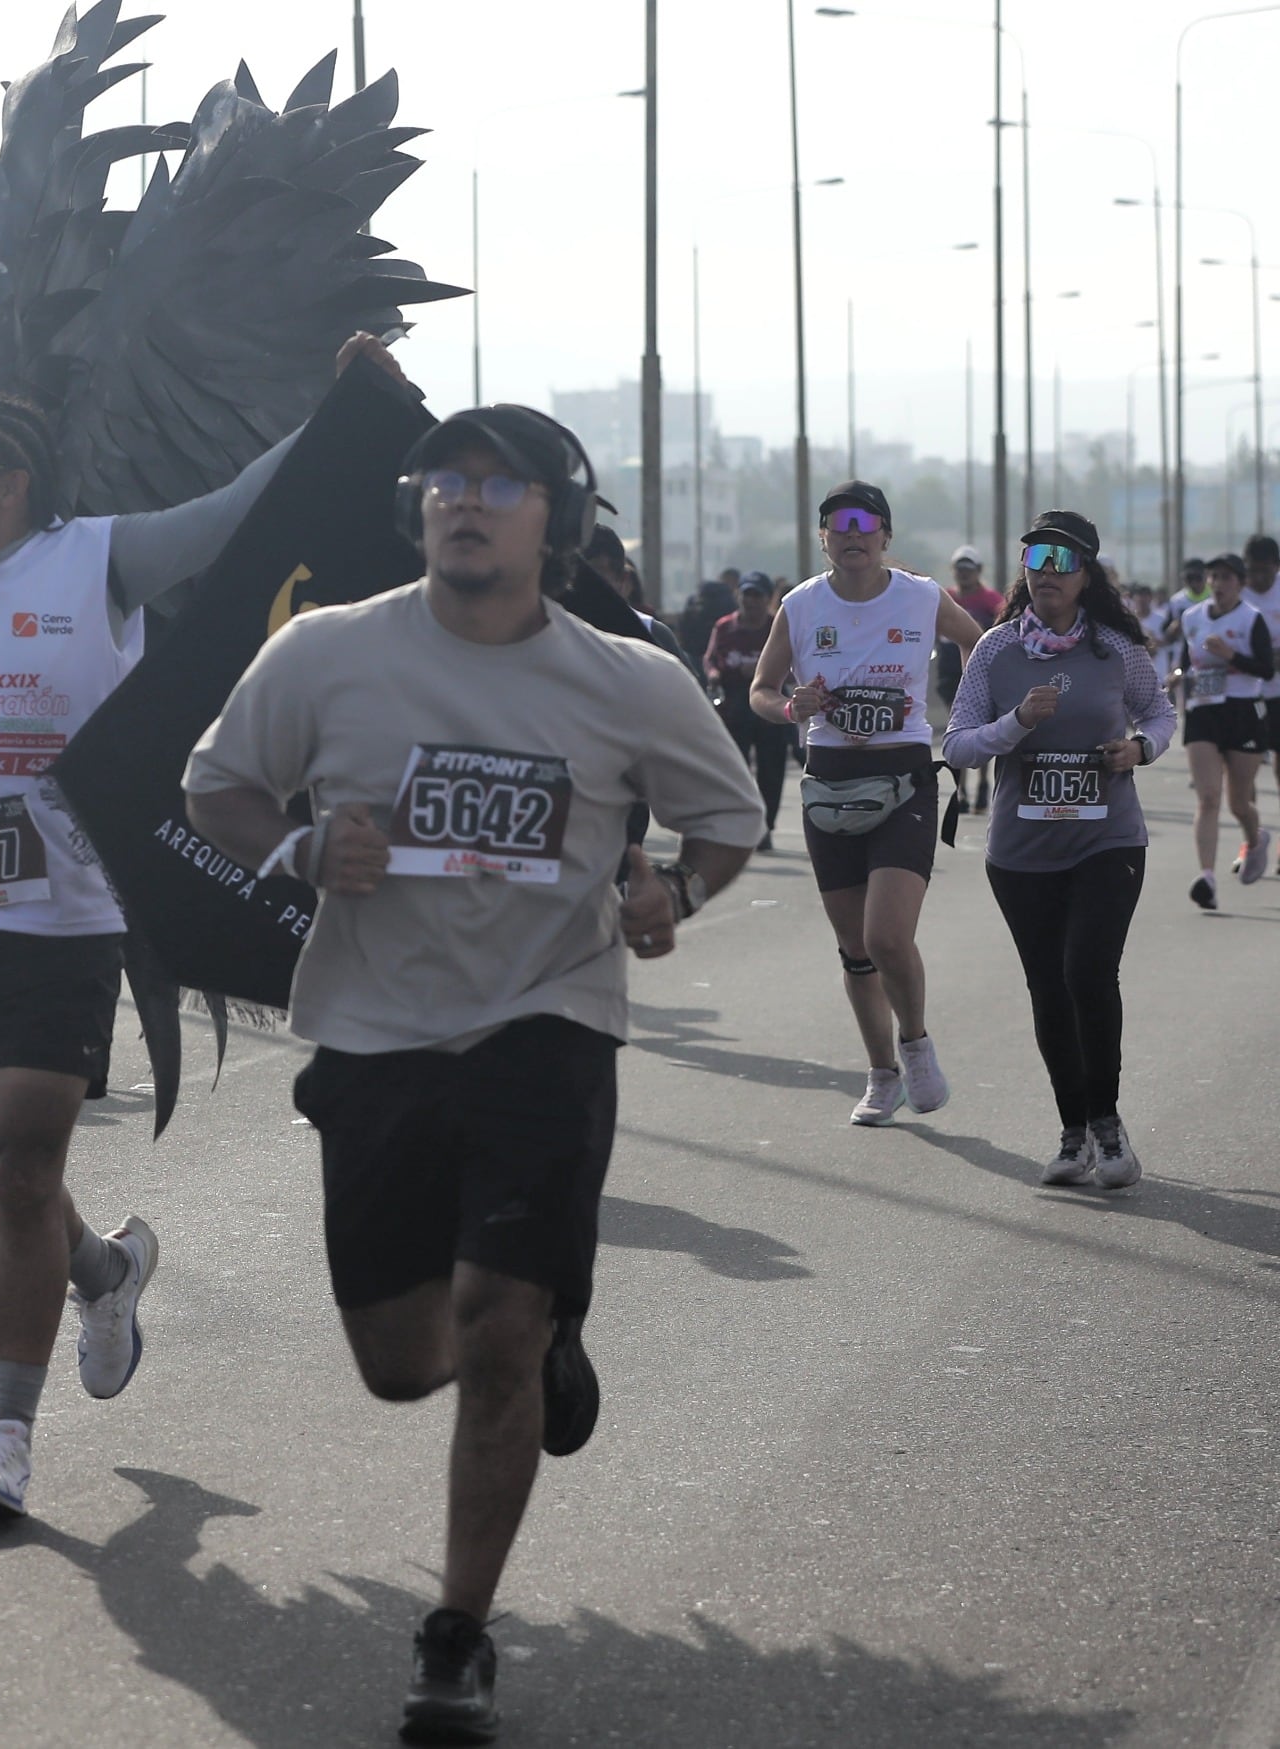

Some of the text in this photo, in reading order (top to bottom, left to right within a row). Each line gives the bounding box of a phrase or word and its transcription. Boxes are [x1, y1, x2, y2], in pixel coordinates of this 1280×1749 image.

[41, 613, 72, 625] Cerro
[41, 624, 74, 636] Verde
[868, 664, 904, 674] XXXIX
[845, 689, 886, 700] ITPOINT
[433, 750, 532, 778] FITPOINT
[1036, 753, 1089, 764] FITPOINT
[1028, 769, 1100, 804] 4054
[409, 777, 553, 850] 5642
[154, 819, 257, 900] AREQUIPA
[277, 904, 314, 941] PE
